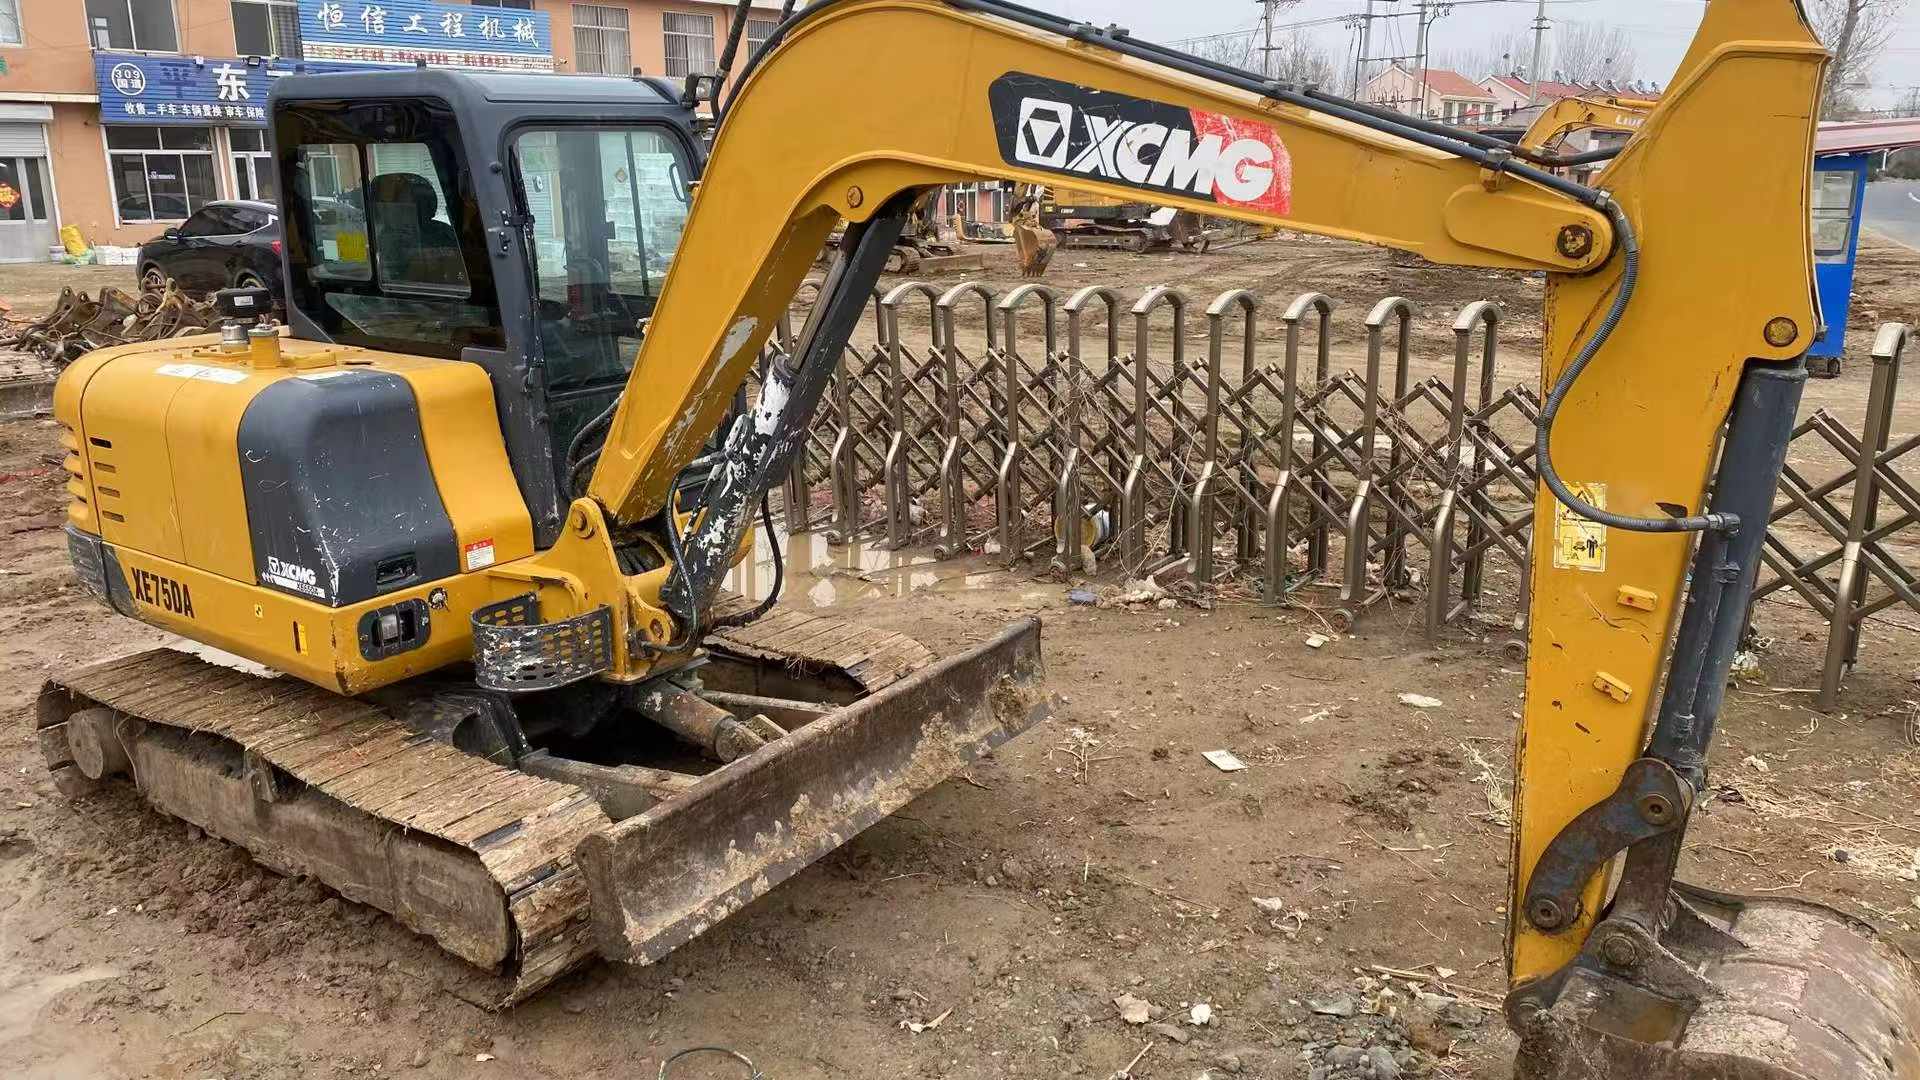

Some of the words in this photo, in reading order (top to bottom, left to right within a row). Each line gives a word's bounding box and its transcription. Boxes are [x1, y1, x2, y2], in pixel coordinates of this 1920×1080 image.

[317, 2, 539, 48] 恒信工程机械
[114, 69, 140, 79] 309
[116, 78, 141, 89] 国道
[246, 106, 265, 119] 保险
[1065, 113, 1274, 202] XCMG
[280, 561, 317, 586] XCMG
[131, 567, 195, 619] XE75DA
